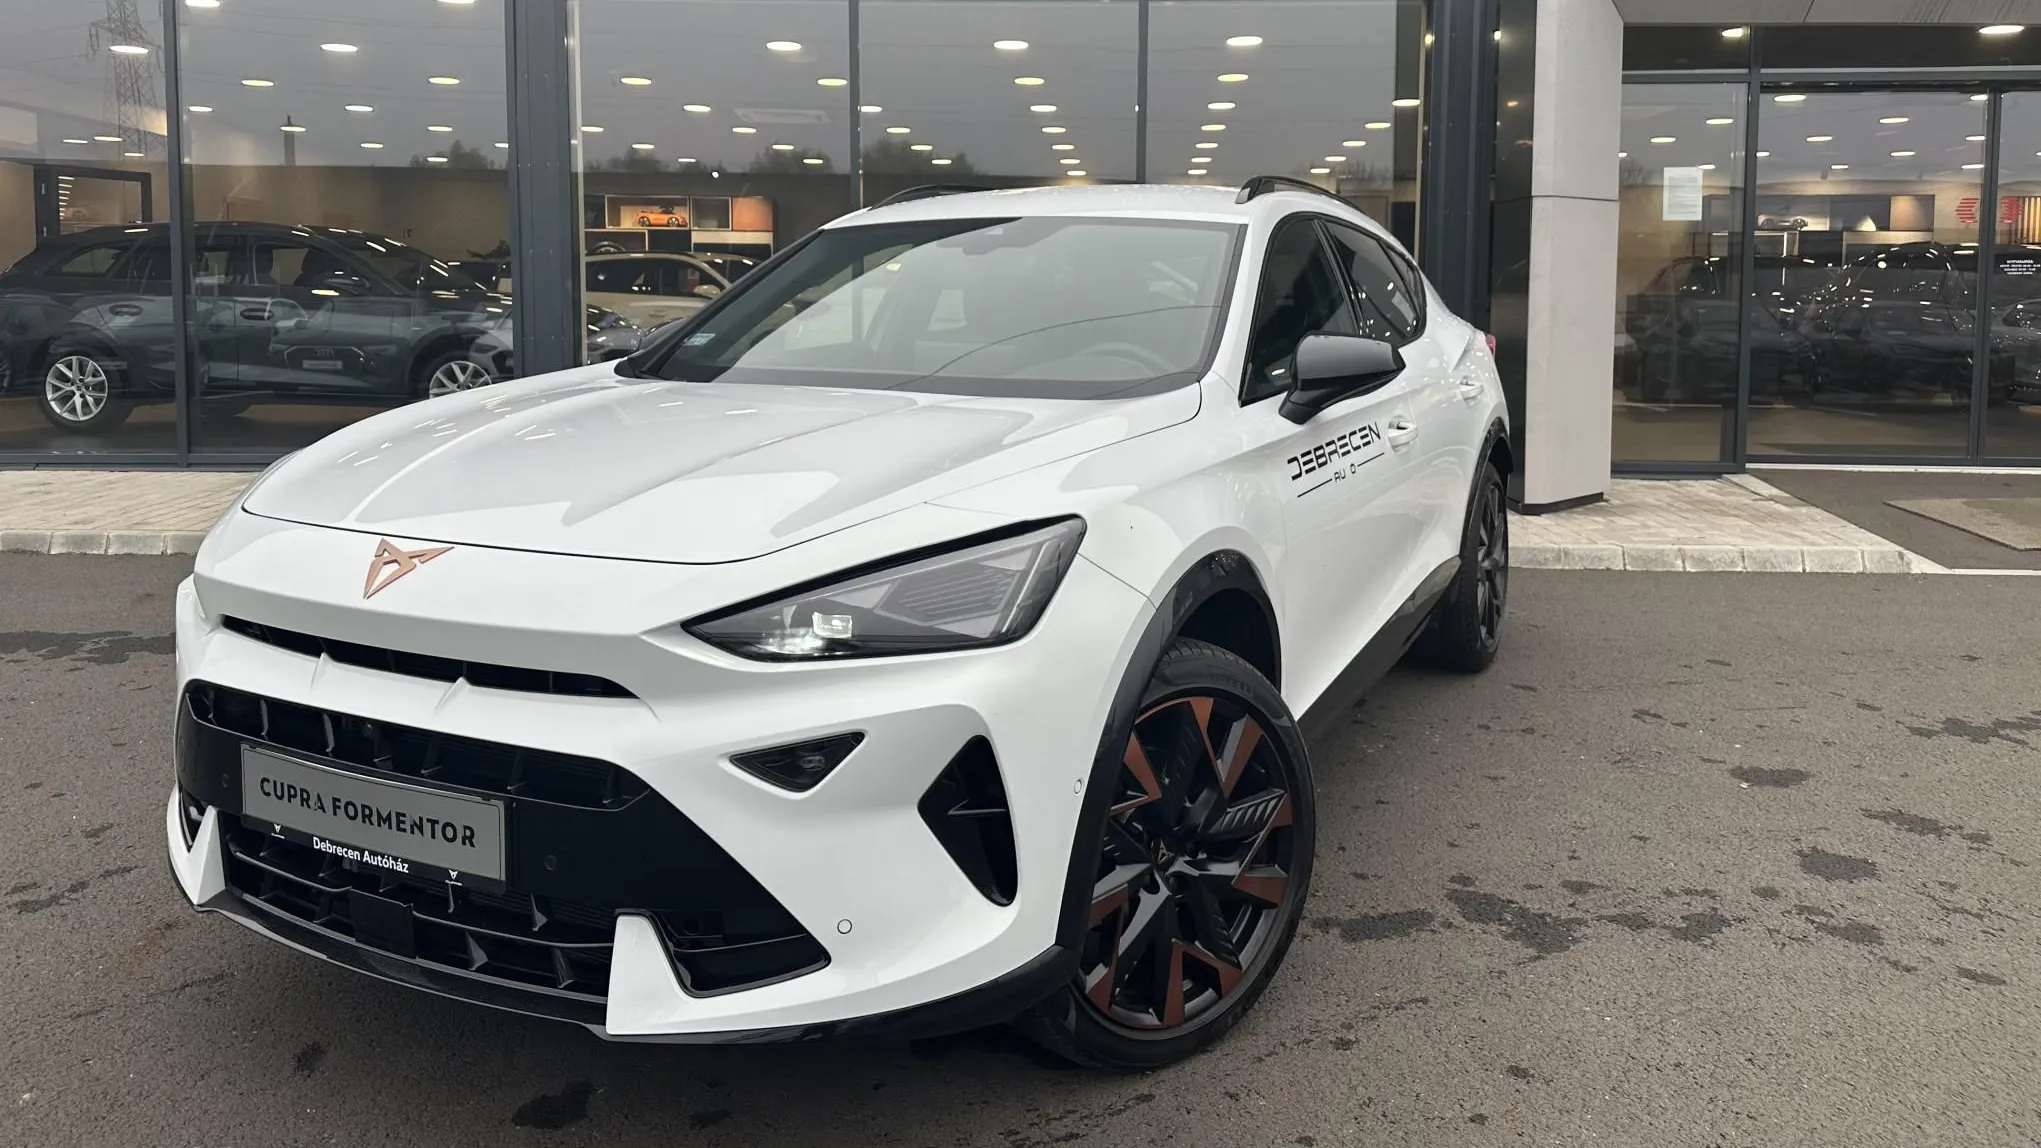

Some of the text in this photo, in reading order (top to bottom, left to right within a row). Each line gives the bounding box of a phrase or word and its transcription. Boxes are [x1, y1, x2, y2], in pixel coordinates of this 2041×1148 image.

[1287, 421, 1381, 481] DEBRECEN
[1334, 463, 1357, 483] AUO
[260, 777, 476, 848] CUPRA FORMENTOR
[313, 836, 409, 874] Debrecen Autóház
